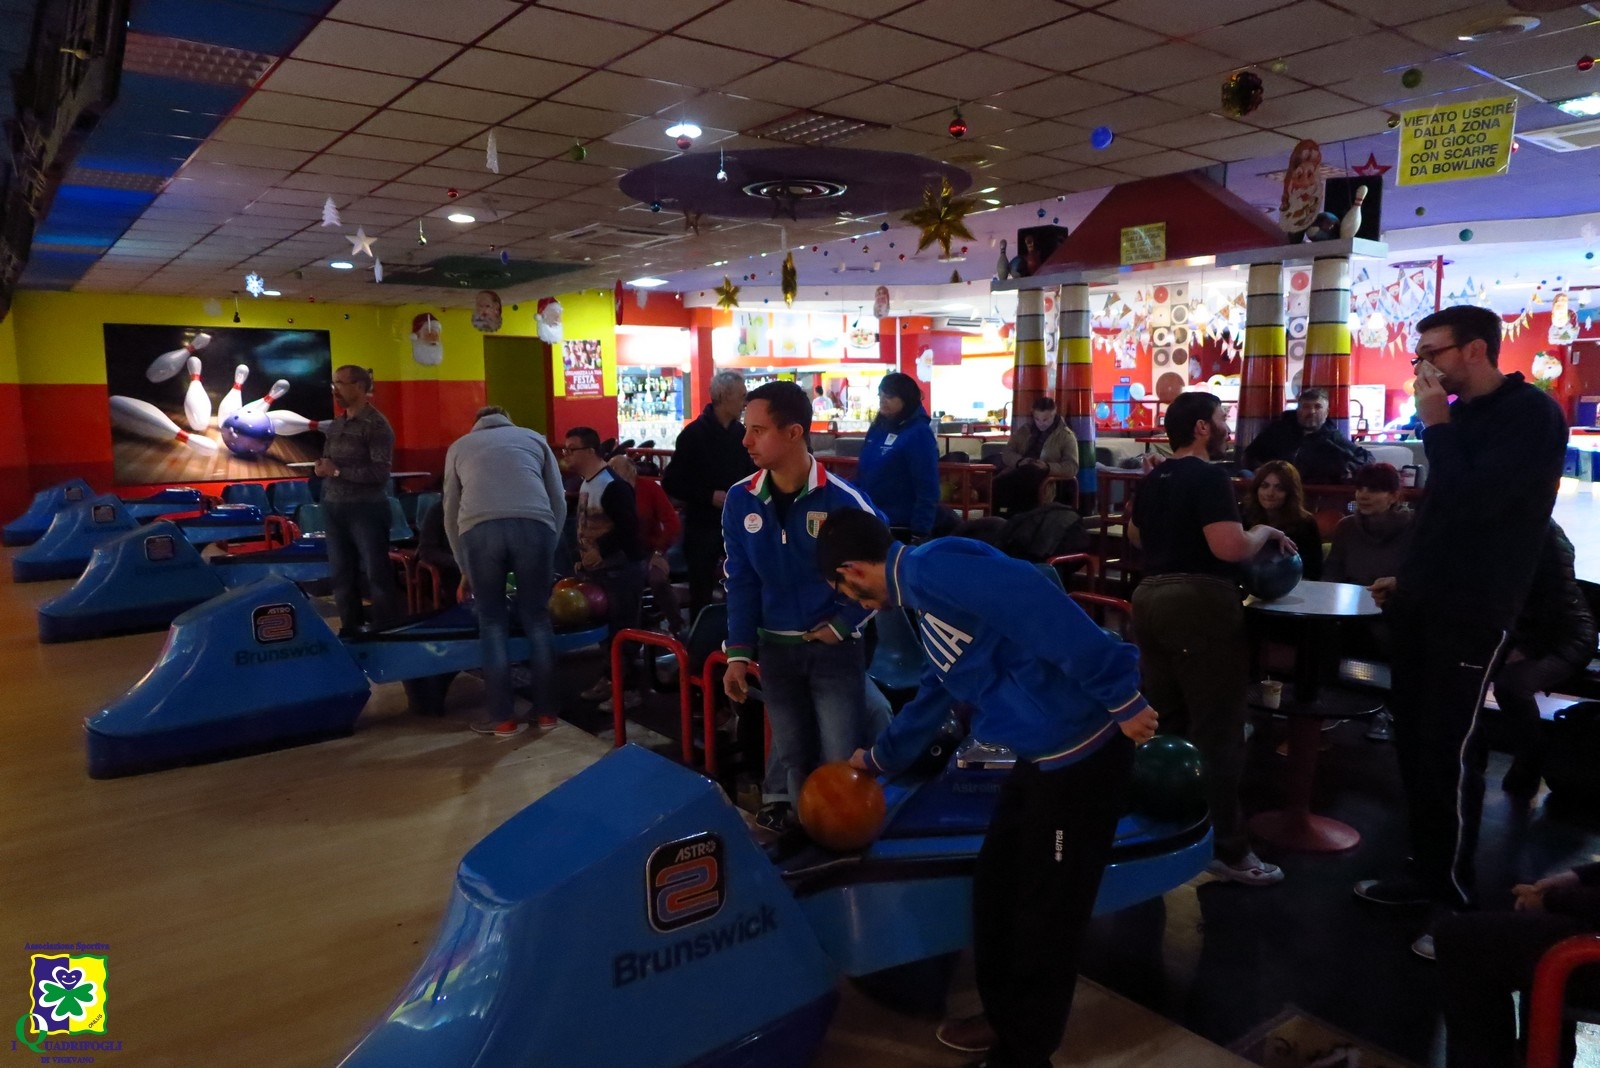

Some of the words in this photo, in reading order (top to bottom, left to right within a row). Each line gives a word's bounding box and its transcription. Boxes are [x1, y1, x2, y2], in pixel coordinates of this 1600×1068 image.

[1403, 111, 1457, 127] VIETATO
[1462, 102, 1515, 119] USCIRE
[1413, 123, 1456, 139] DALLA
[1461, 118, 1500, 133] ZONA
[1424, 139, 1437, 150] DI
[1441, 132, 1487, 148] GIOCO
[1410, 151, 1439, 164] CON
[1444, 143, 1499, 160] SCARPE
[1410, 166, 1428, 177] DA
[1432, 157, 1496, 174] BOWLING
[573, 375, 595, 384] FESTA
[267, 607, 291, 615] ASTRO
[234, 639, 329, 667] Brunswick
[675, 840, 717, 863] ASTRO
[655, 855, 720, 922] 2
[613, 902, 778, 988] Brunswick
